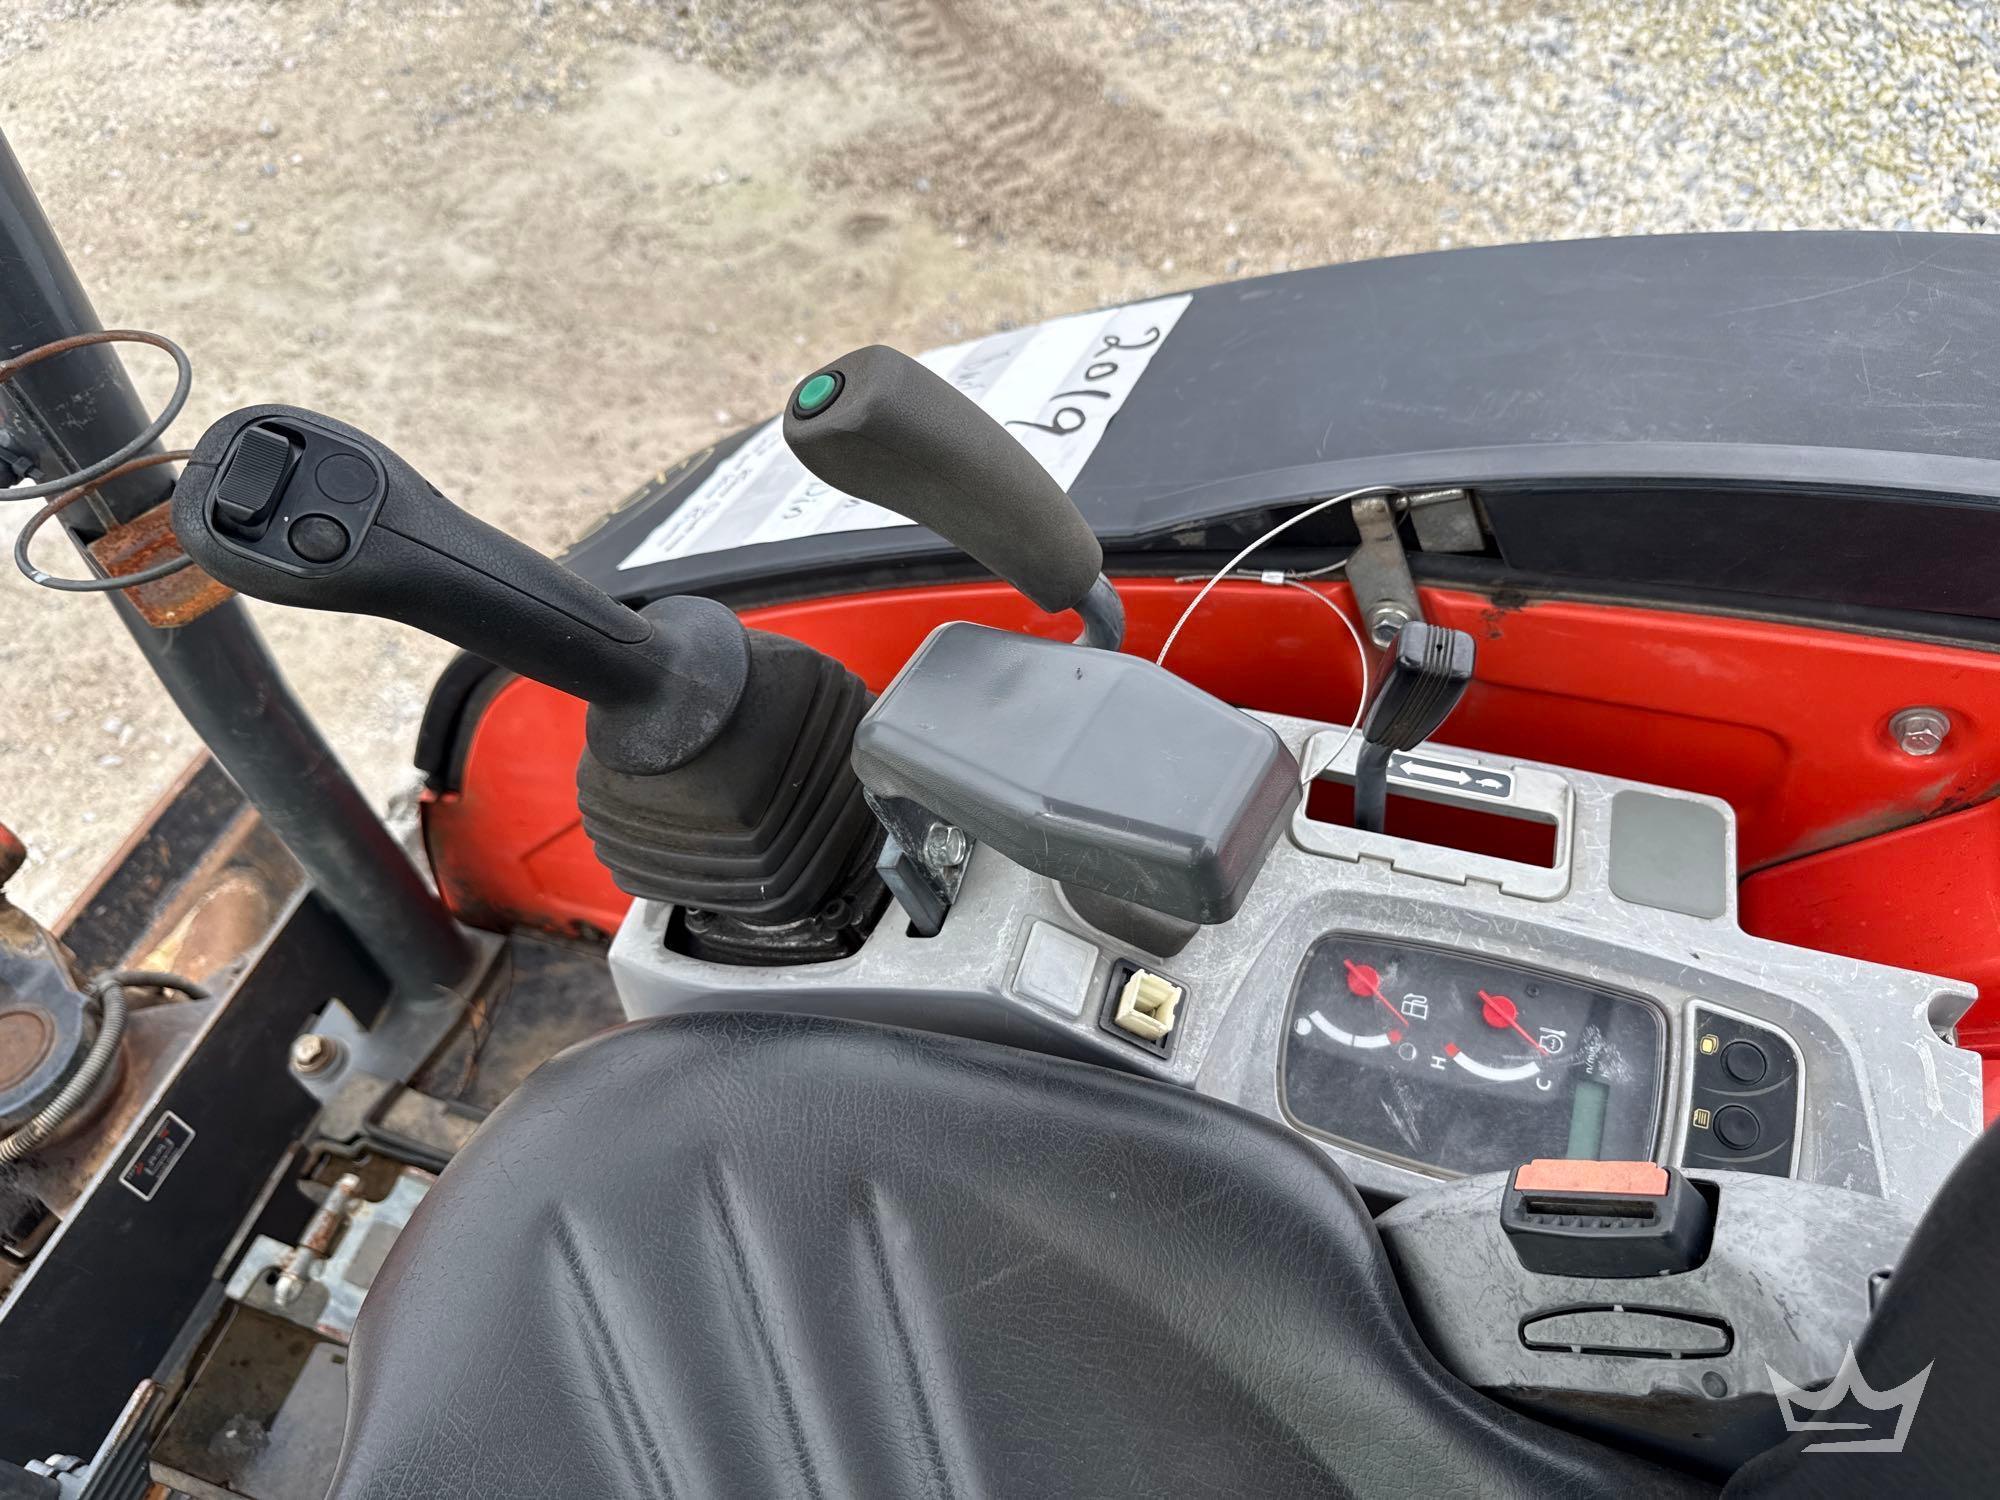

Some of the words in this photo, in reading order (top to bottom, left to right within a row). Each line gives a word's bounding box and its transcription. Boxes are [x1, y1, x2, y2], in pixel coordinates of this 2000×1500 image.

[1005, 326, 1161, 437] 2019
[1429, 1055, 1447, 1071] H
[1536, 1077, 1552, 1091] C
